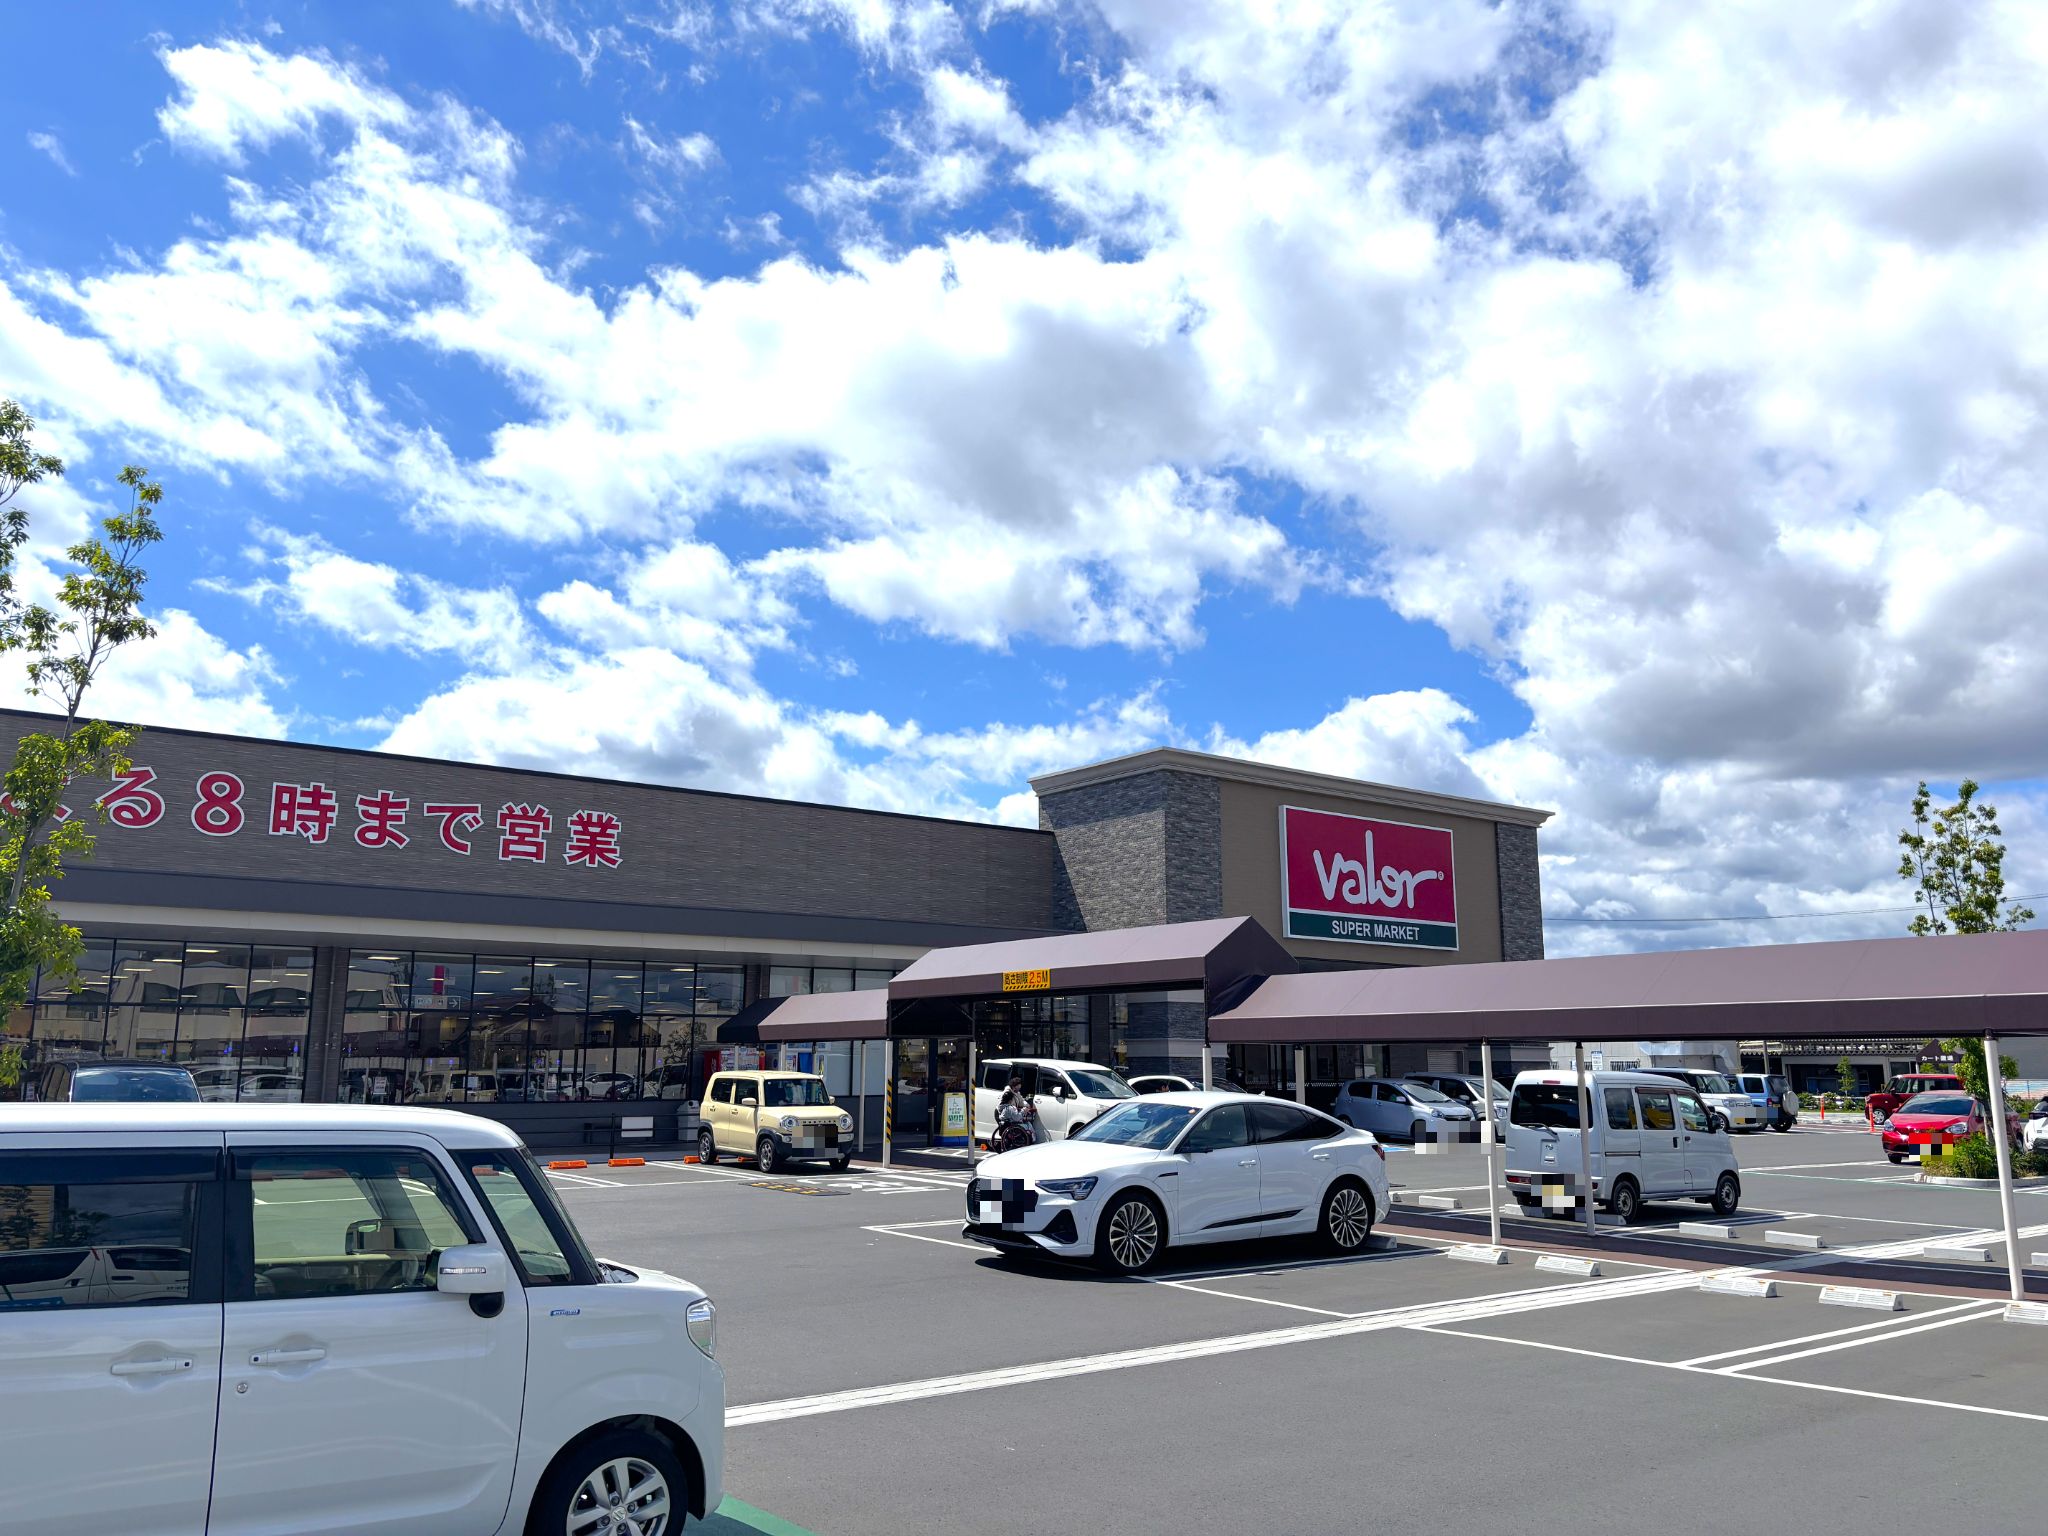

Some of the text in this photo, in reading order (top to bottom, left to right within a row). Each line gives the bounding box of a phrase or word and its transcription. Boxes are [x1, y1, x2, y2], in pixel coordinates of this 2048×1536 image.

[0, 766, 623, 868] る8時まで営業
[1331, 919, 1420, 941] SUPER MARKET
